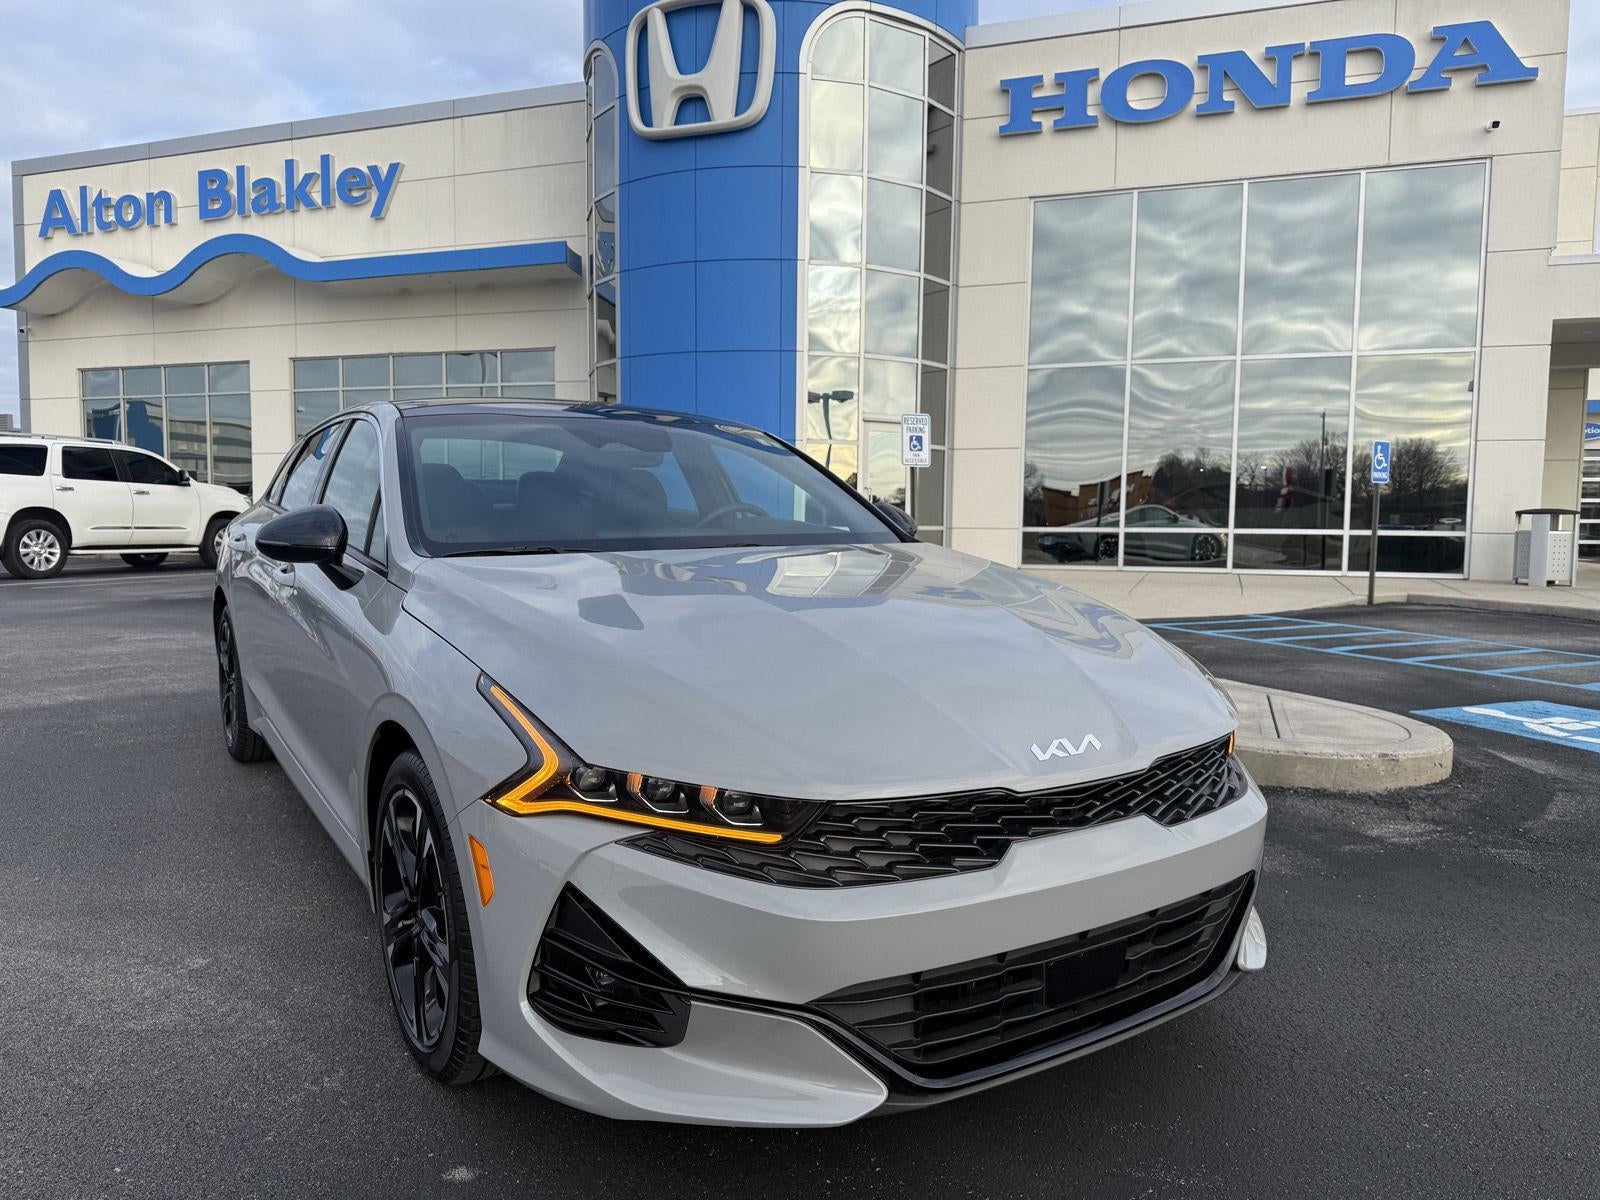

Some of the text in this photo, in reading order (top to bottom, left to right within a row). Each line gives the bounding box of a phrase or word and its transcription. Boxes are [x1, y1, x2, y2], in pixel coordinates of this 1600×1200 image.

[998, 19, 1538, 136] HONDA
[38, 154, 403, 239] Alton Blakley
[904, 416, 928, 426] RESERVED
[1030, 734, 1101, 761] KIA
